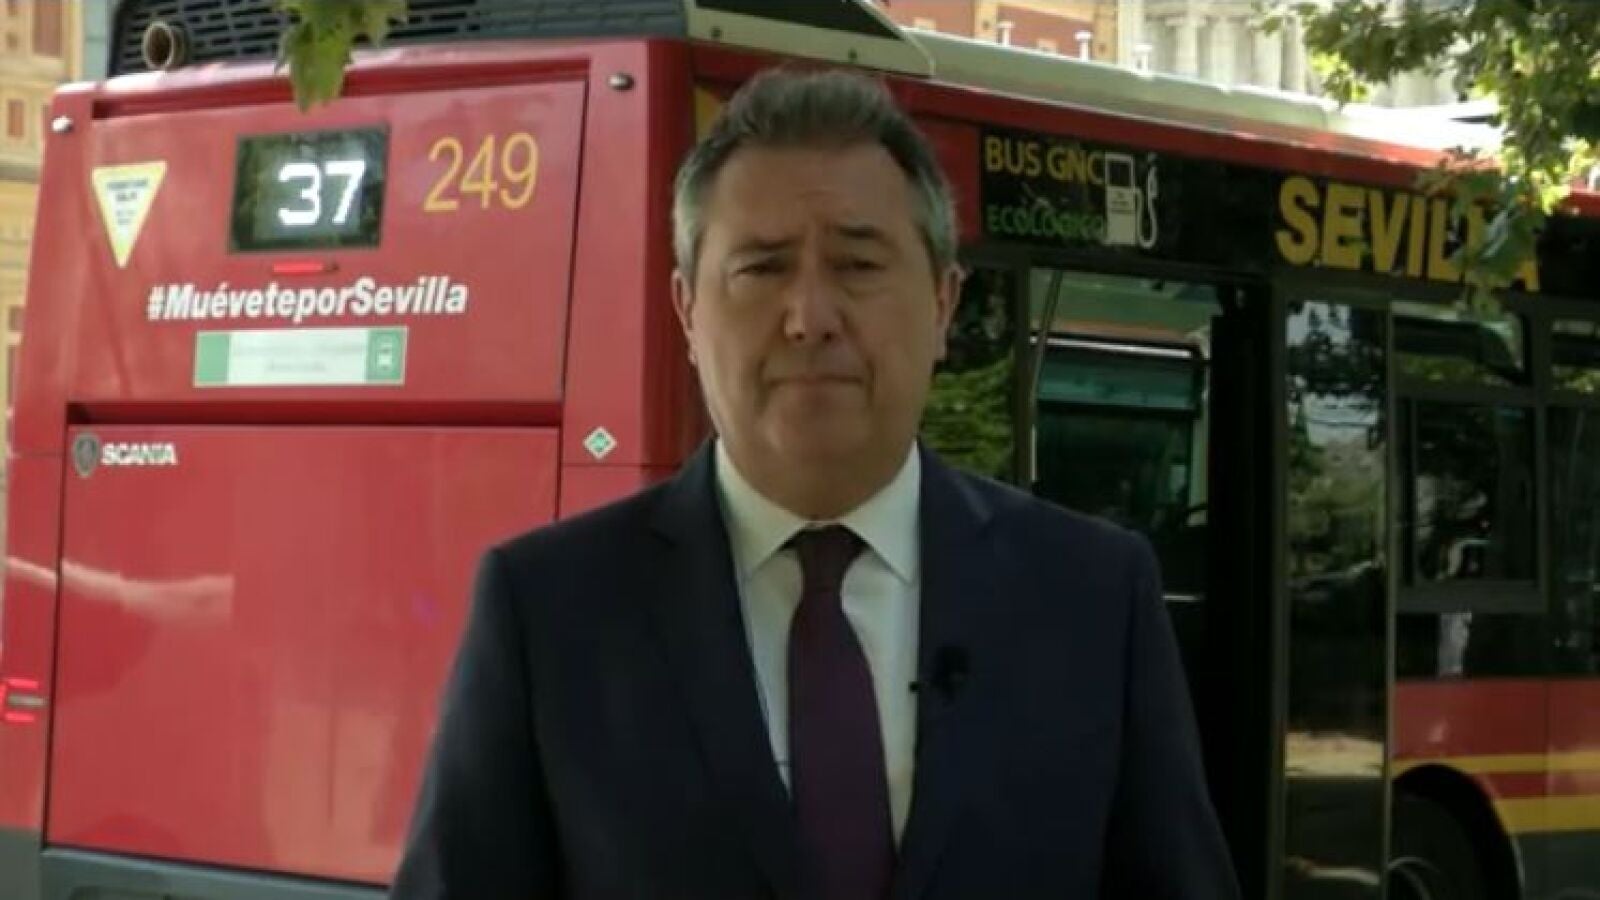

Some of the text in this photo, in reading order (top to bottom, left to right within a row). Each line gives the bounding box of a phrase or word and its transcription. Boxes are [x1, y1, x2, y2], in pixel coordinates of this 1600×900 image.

[423, 132, 538, 212] 249
[984, 135, 1105, 184] BUS GNC
[277, 160, 366, 226] 37
[1275, 175, 1540, 292] SEVIL
[147, 275, 469, 323] #MuéveteporSevilla
[101, 442, 178, 466] SCANIA
